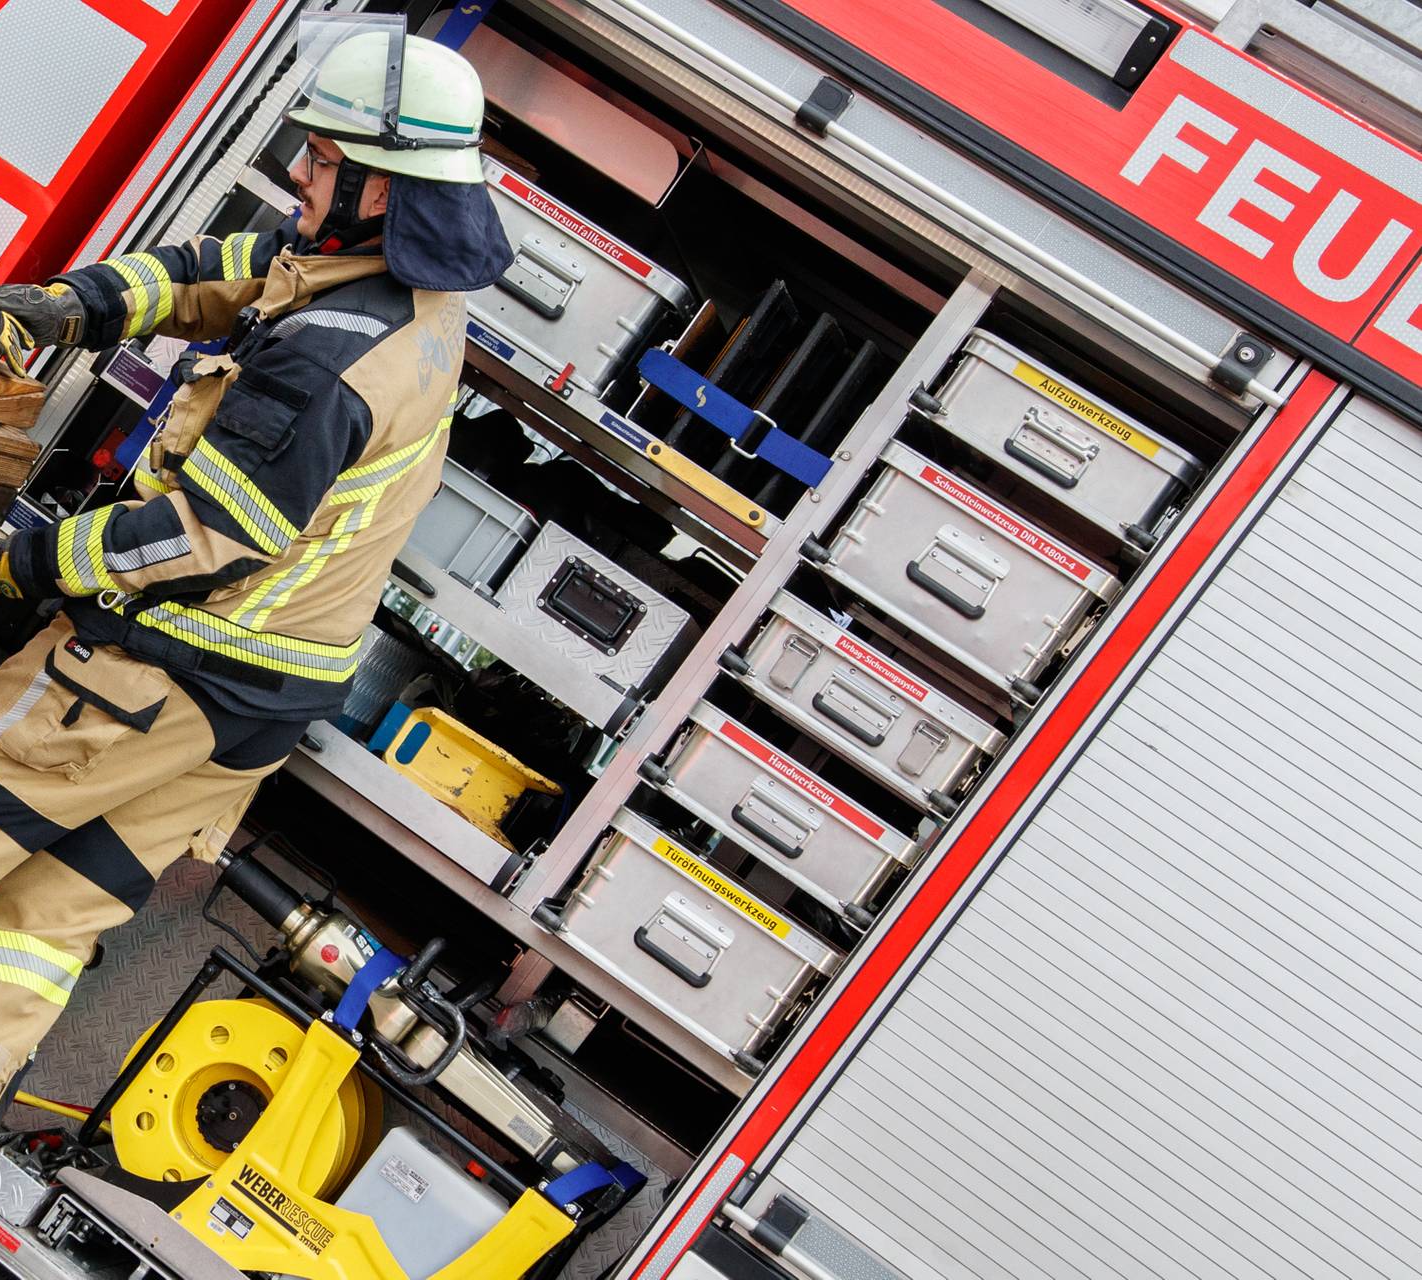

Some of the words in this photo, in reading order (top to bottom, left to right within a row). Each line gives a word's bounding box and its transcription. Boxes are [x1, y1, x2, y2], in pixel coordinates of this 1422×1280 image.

[526, 190, 624, 260] Verkehrsunfallkoffer
[1039, 379, 1132, 441] Aufzugwerkzeug
[933, 475, 1020, 536] Schornsteinwerkzeug
[1020, 530, 1039, 547] DIN
[1038, 541, 1077, 571] 14800-4
[839, 639, 925, 698] Airbag-Sicherungssystem
[768, 754, 835, 807] Handwerkzeug
[664, 845, 778, 931] Türöffnungswerkzeug
[299, 1234, 322, 1256] SYSTEMS
